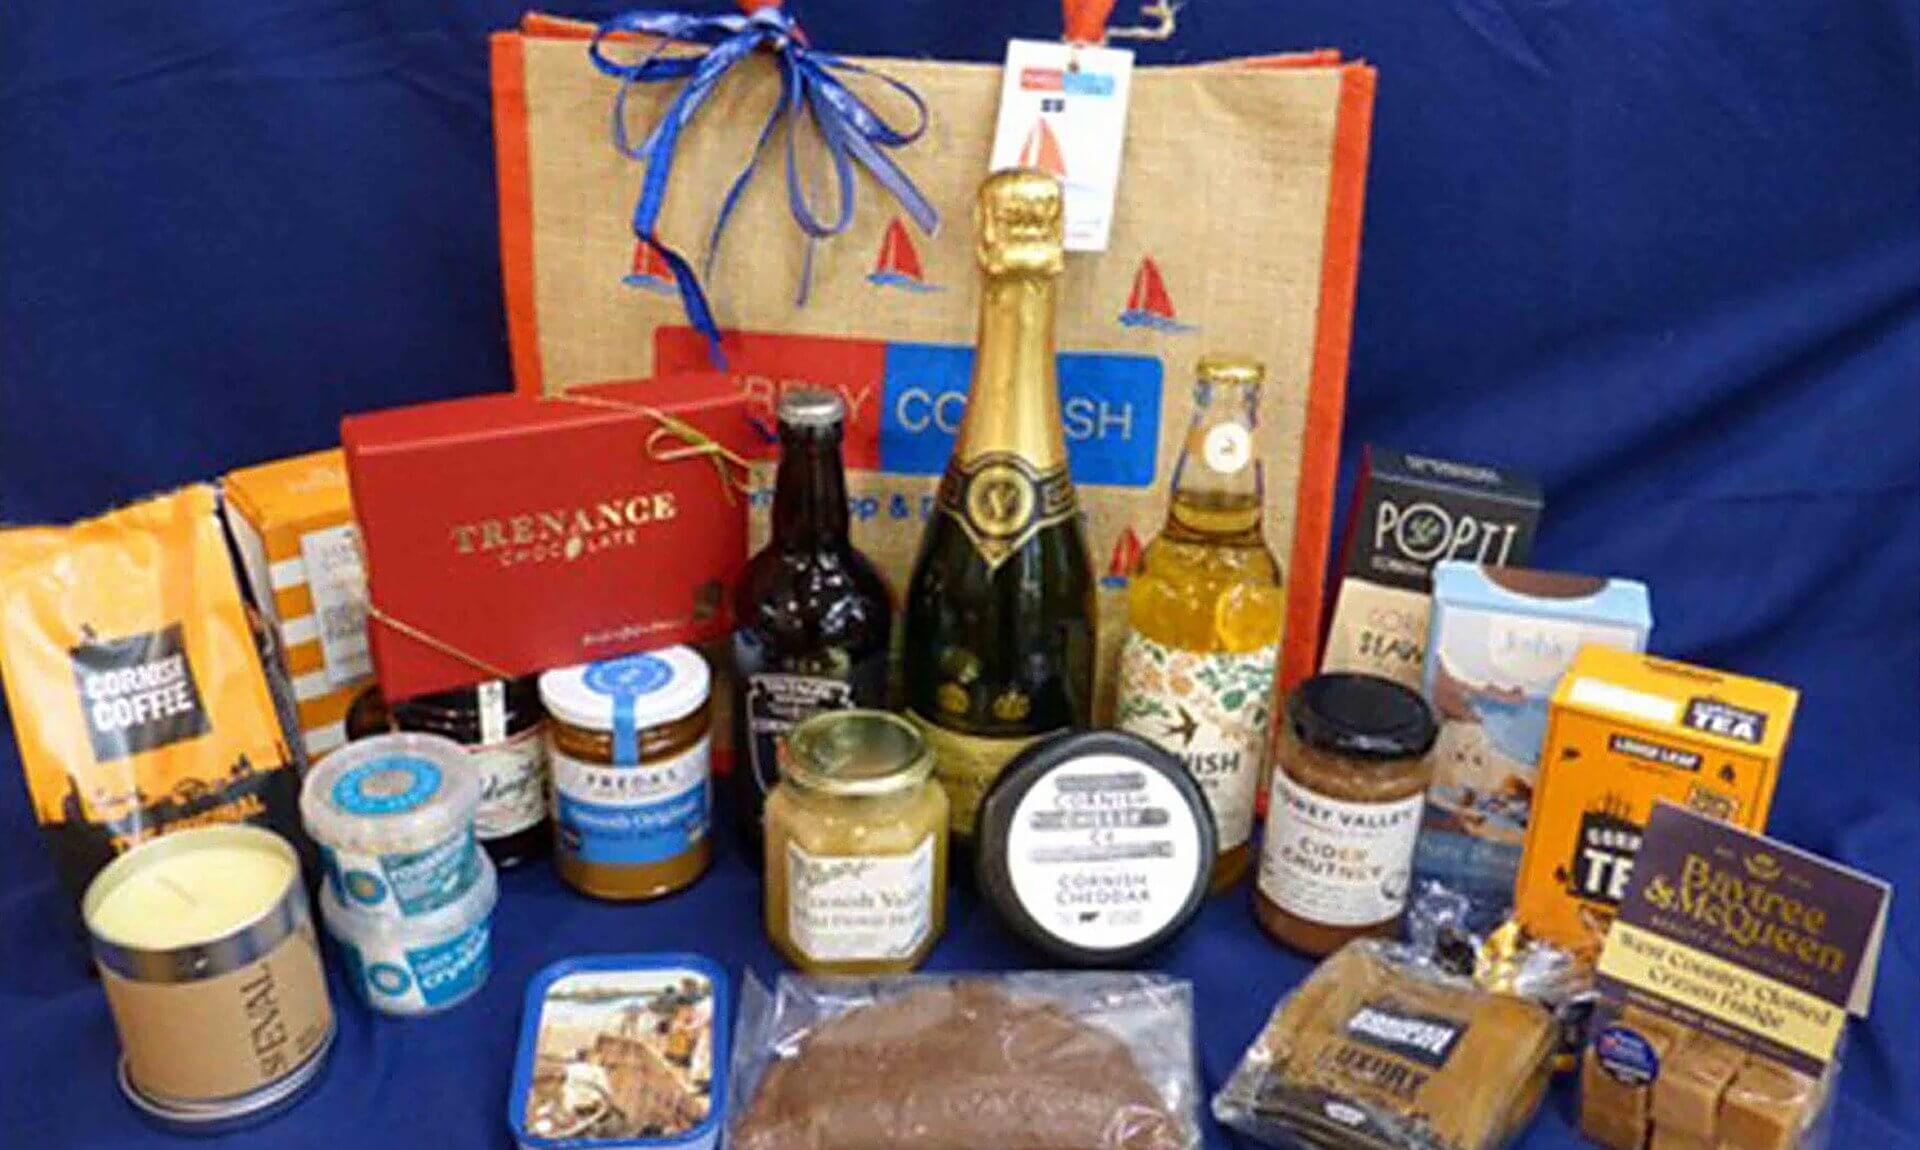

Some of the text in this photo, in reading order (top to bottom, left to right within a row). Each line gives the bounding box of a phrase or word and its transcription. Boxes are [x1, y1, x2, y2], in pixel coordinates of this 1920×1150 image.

[452, 491, 677, 553] TRENANCE
[92, 682, 194, 732] COFFEE
[1693, 714, 1756, 742] TEA
[1583, 849, 1636, 900] TE
[1683, 853, 1828, 932] Baytree
